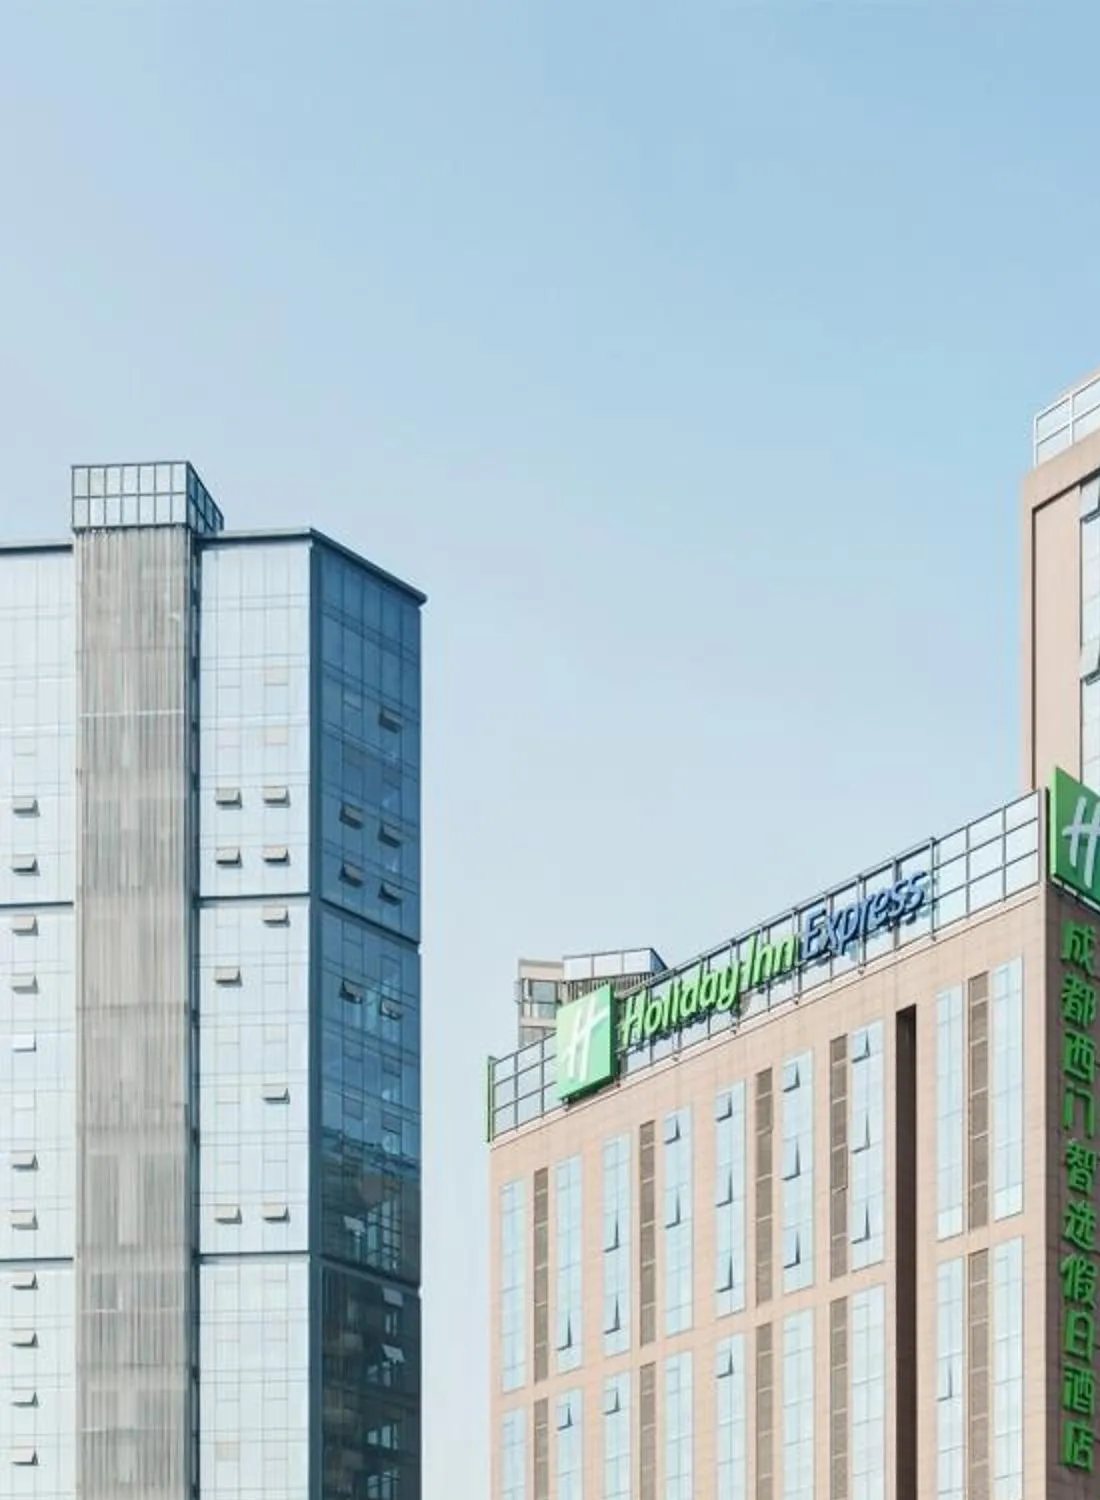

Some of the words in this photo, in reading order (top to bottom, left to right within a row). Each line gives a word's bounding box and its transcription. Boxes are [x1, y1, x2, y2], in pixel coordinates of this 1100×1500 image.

[621, 958, 740, 1046] Holiday
[740, 933, 797, 993] Inn
[800, 871, 927, 961] Express
[1061, 920, 1096, 1473] 成都西门智选假日酒店
